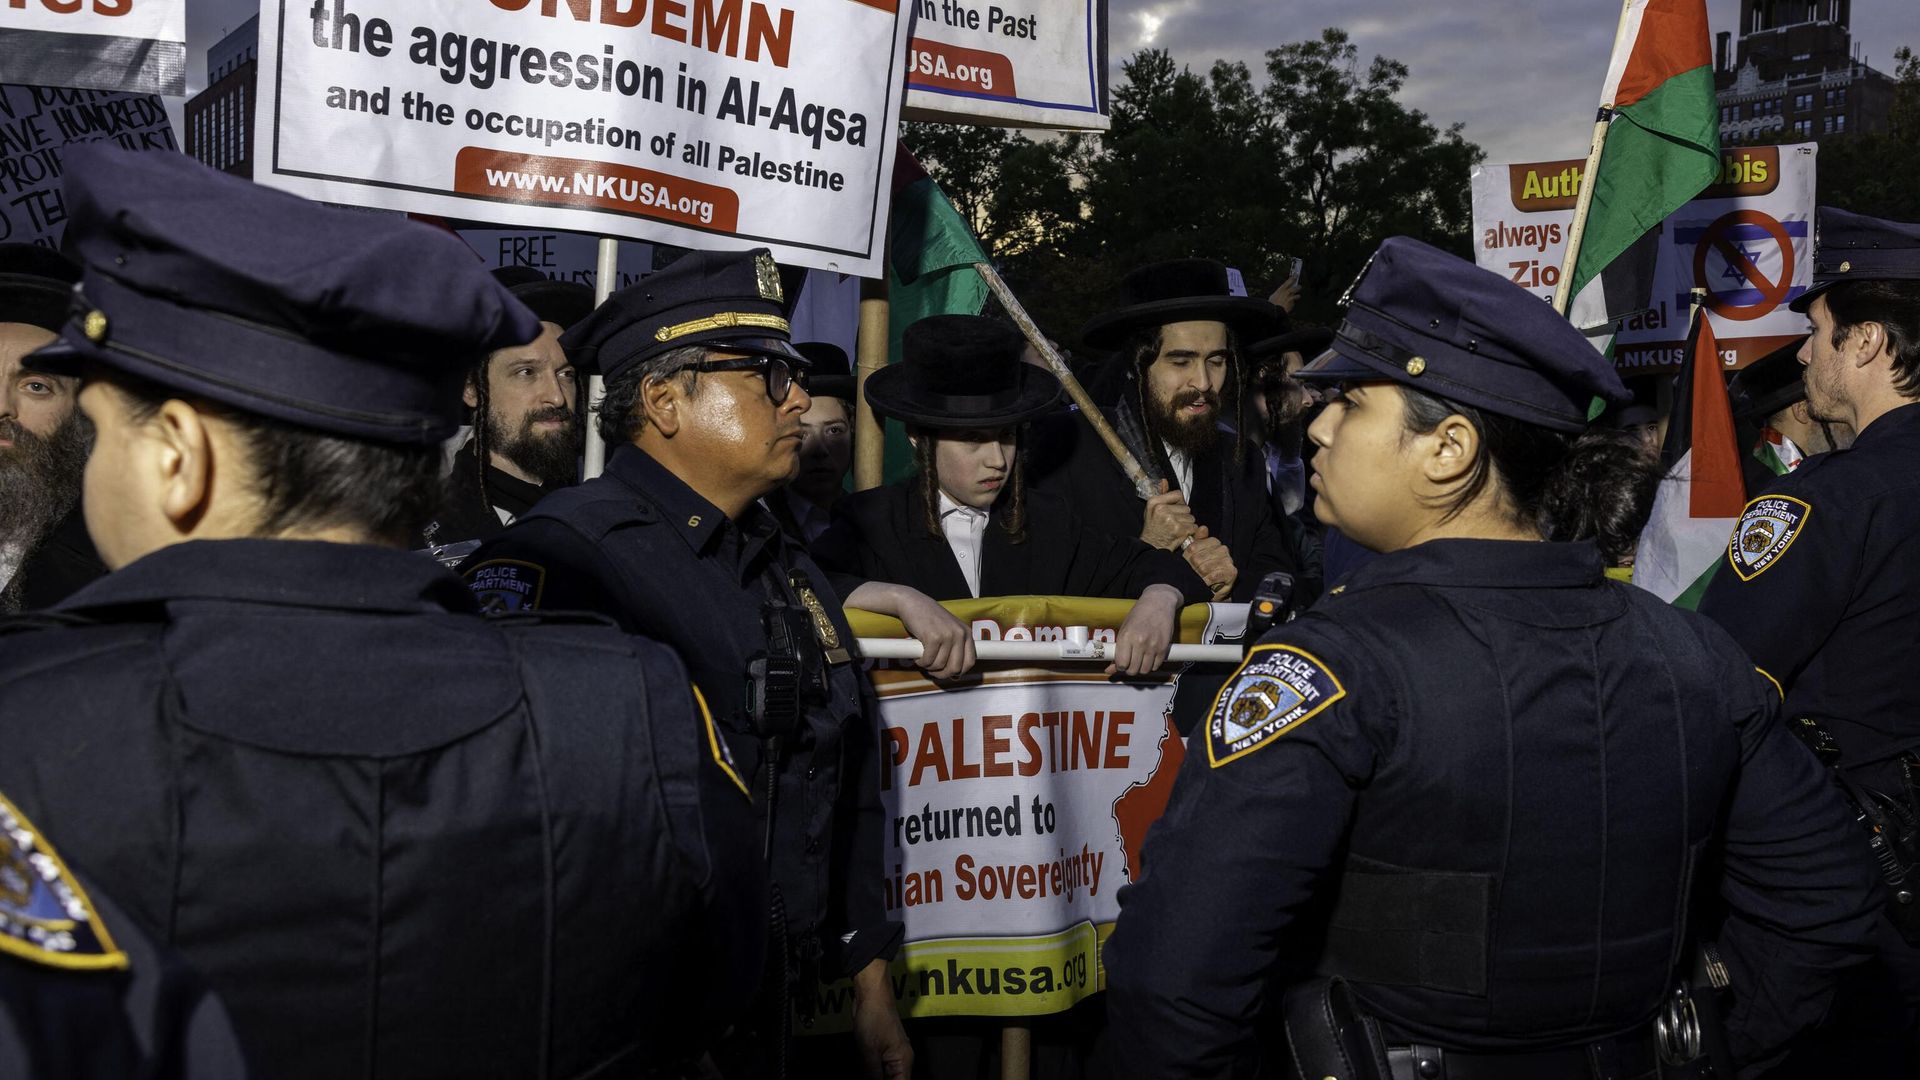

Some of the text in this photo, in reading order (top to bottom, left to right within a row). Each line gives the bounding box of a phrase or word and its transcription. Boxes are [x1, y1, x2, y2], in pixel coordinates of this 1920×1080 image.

[942, 0, 981, 30] the
[987, 6, 1037, 40] Past
[310, 0, 867, 150] the aggression in Al-Aqsa
[51, 94, 168, 140] HUNDREDS
[326, 85, 844, 192] and the occupation of all Palestine
[1714, 154, 1768, 184] bis
[485, 168, 714, 224] www.NKUSA.org
[499, 235, 557, 268] FREE
[1484, 221, 1562, 253] always
[687, 515, 702, 528] 6
[1741, 508, 1799, 524] DEPARTMENT
[1755, 500, 1790, 511] POLICE
[1733, 551, 1743, 564] OF
[1753, 552, 1773, 571] NEW
[1771, 529, 1795, 554] YORK
[468, 577, 533, 596] PARTMENT
[475, 566, 518, 579] POLICE
[1240, 663, 1320, 702] DEPARTMENT
[1266, 652, 1317, 679] POLICE
[1212, 687, 1309, 752] CITY OF NEW YORK
[880, 711, 1136, 792] PALESTINE
[893, 794, 1057, 848] returned to
[954, 842, 1105, 905] Sovereignty
